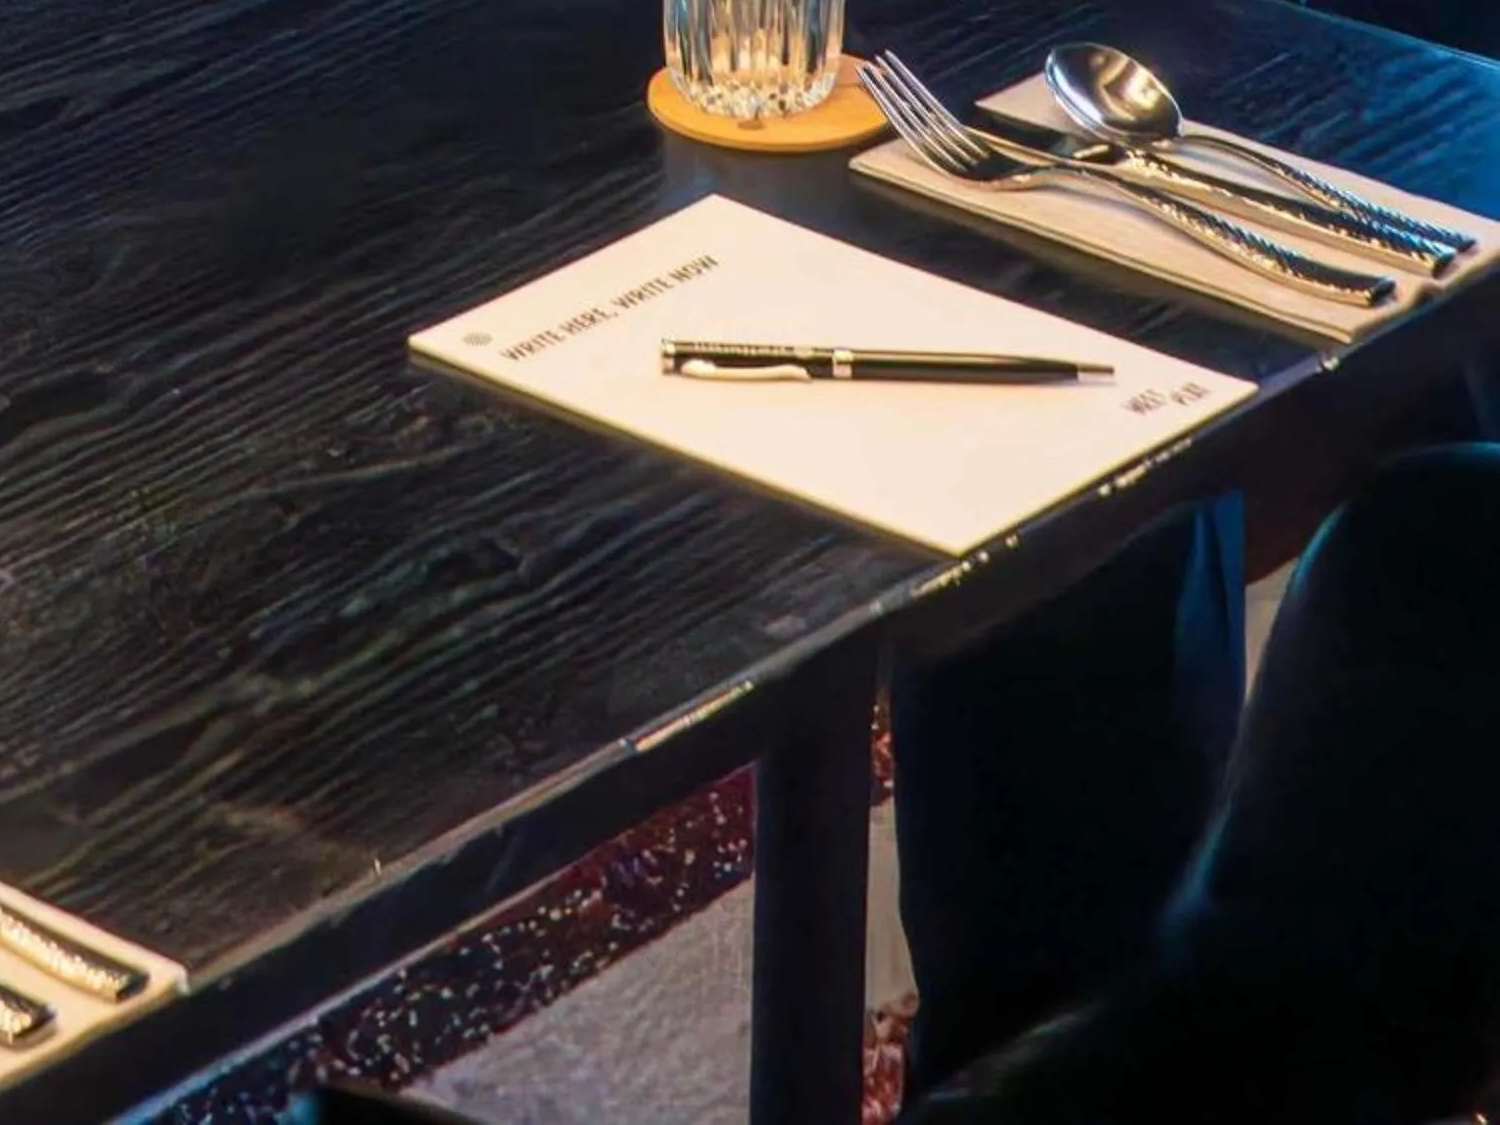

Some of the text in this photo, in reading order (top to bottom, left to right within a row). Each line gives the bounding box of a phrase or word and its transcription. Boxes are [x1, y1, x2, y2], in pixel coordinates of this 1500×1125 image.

[501, 255, 719, 361] WRITE HERE, WRITE NOW
